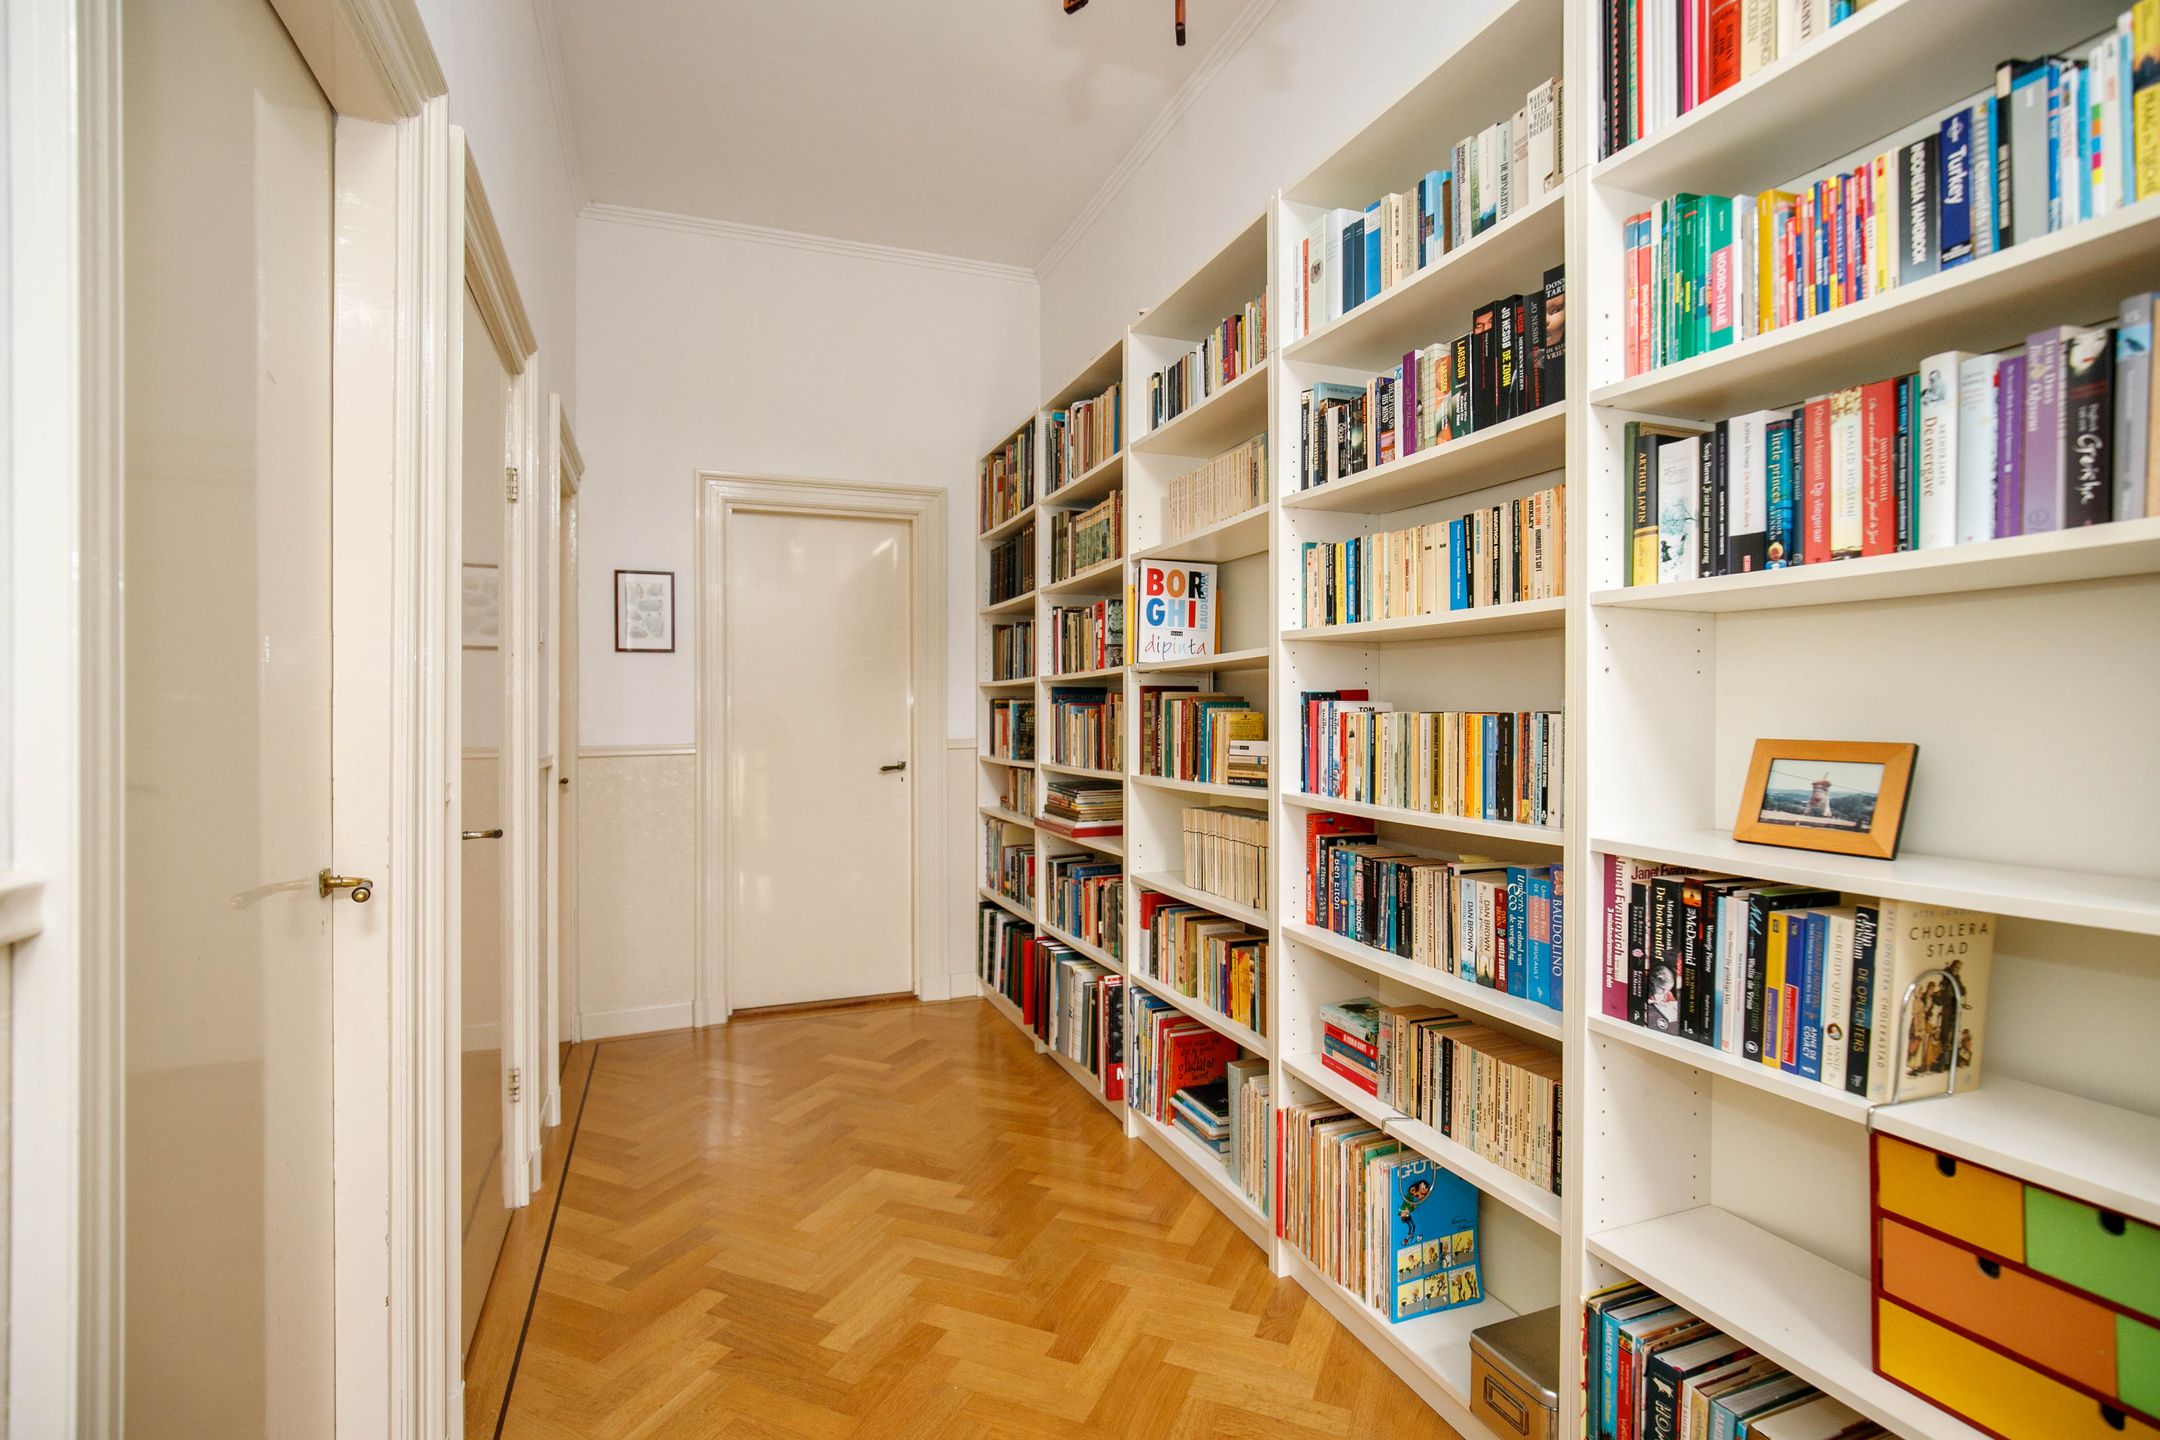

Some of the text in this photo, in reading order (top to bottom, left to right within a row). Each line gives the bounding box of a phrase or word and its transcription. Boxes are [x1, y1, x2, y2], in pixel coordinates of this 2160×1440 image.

[1945, 145, 1967, 205] Turkey
[1910, 141, 1926, 265] INDONESIA HANDBOOK
[1716, 251, 1728, 327] NOORD-ITALIË
[1501, 307, 1511, 387] JO NESBØ DE ZOON
[1531, 316, 1539, 343] NESBØ
[1457, 340, 1466, 378] LARSSON
[1813, 405, 1824, 437] Khaled
[1638, 453, 1646, 493] ARTHUR
[1703, 443, 1712, 461] Sonja
[1703, 462, 1711, 484] Barend
[1768, 432, 1783, 504] little princes
[1814, 440, 1824, 480] Hosseini
[1879, 437, 1888, 502] DAVID MITCHELL
[1921, 416, 1938, 497] De overgave
[2071, 433, 2103, 505] Geisha
[1638, 496, 1646, 523] JAPIN
[1146, 568, 1204, 599] BOR
[1146, 598, 1196, 631] GHI
[1145, 634, 1207, 660] dipinta
[1517, 874, 1525, 912] Umberto
[1631, 866, 1658, 880] Janet
[1614, 858, 1626, 956] Janet Evanovich
[1655, 887, 1665, 962] De boekendief
[1666, 900, 1674, 951] Markus Zusak
[1552, 899, 1562, 976] BAUDOLINO
[1606, 913, 1614, 966] misdaadromans
[1685, 914, 1696, 965] McDermid
[1853, 913, 1869, 959] Grisham
[1862, 921, 1876, 947] John
[1909, 923, 1990, 940] CHOLERA
[1926, 943, 1969, 958] STAD
[1831, 936, 1844, 1020] GREEDY QUEEN
[1853, 968, 1868, 1053] DE OPLICHTERS
[1876, 998, 1890, 1068] CHOLERASTAD
[1802, 1026, 1810, 1058] COURCY
